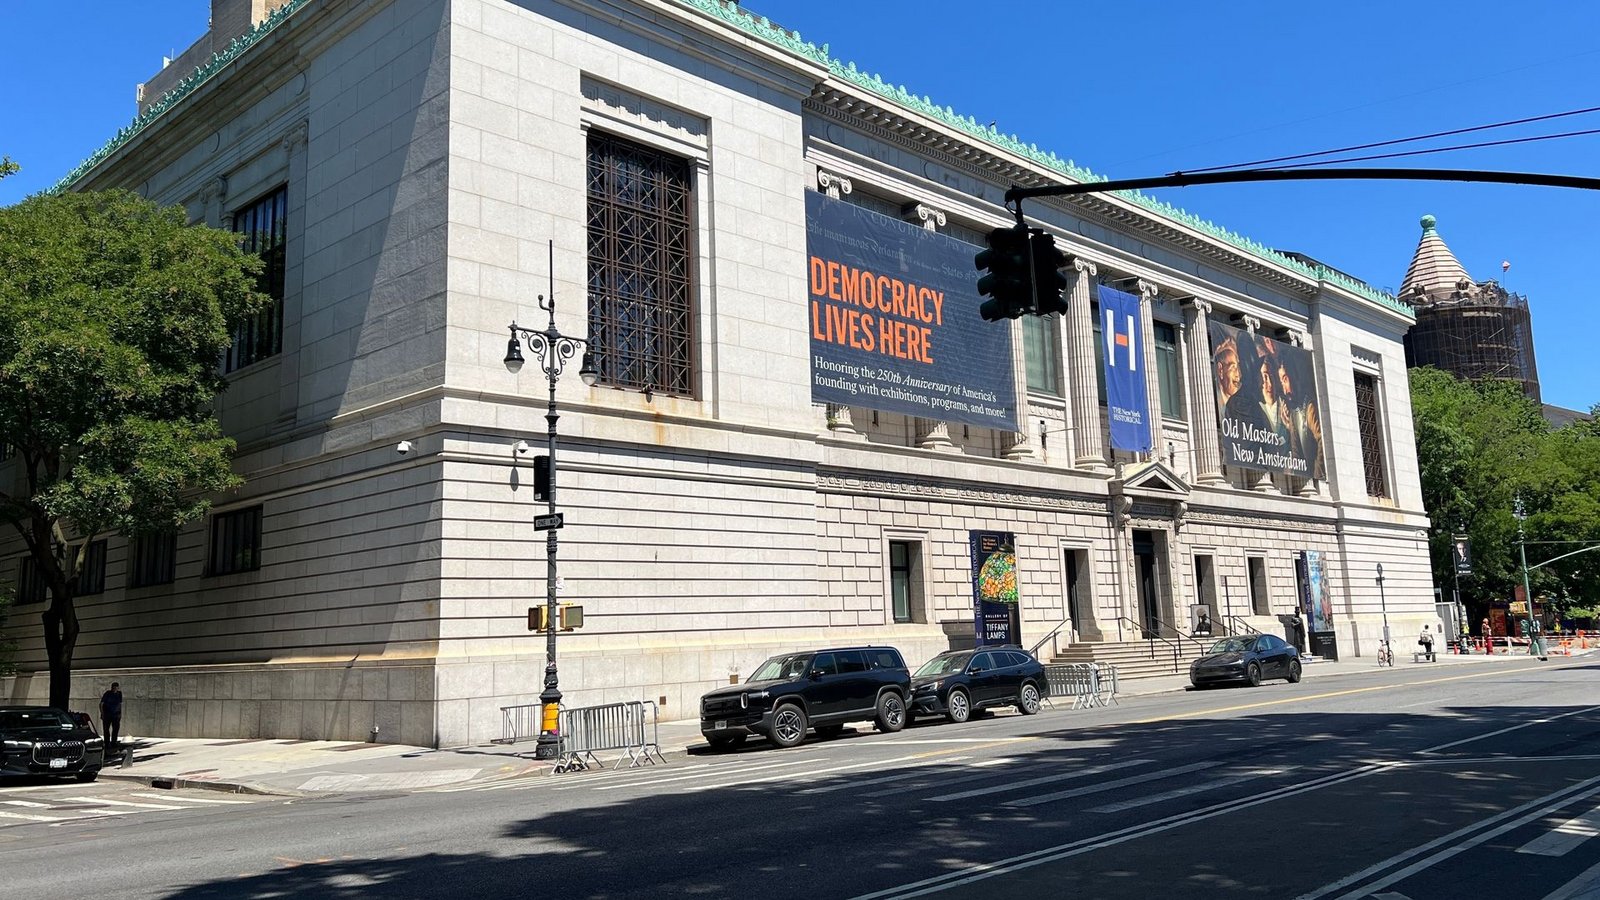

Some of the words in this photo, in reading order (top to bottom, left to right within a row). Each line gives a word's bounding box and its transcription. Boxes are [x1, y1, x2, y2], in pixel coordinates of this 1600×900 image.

[811, 256, 944, 326] DEMOCRACY
[812, 301, 875, 352] LIVES
[879, 317, 934, 364] HERE
[814, 355, 860, 379] Honoring
[861, 365, 876, 379] the
[876, 368, 902, 384] 250th
[901, 374, 953, 396] Anniversary
[952, 384, 961, 395] of
[962, 386, 997, 403] America's
[815, 373, 857, 395] founding
[858, 382, 880, 396] with
[880, 386, 930, 407] exhibitions,
[931, 396, 970, 411] programs,
[970, 403, 985, 414] and
[985, 407, 1007, 418] more!
[1221, 417, 1240, 439] Old
[1241, 421, 1280, 446] Masters
[1231, 441, 1255, 463] New
[1256, 446, 1308, 472] Amsterdam
[537, 519, 547, 527] ONE
[986, 623, 1009, 631] TIFFANY
[986, 631, 1006, 640] LAMPS
